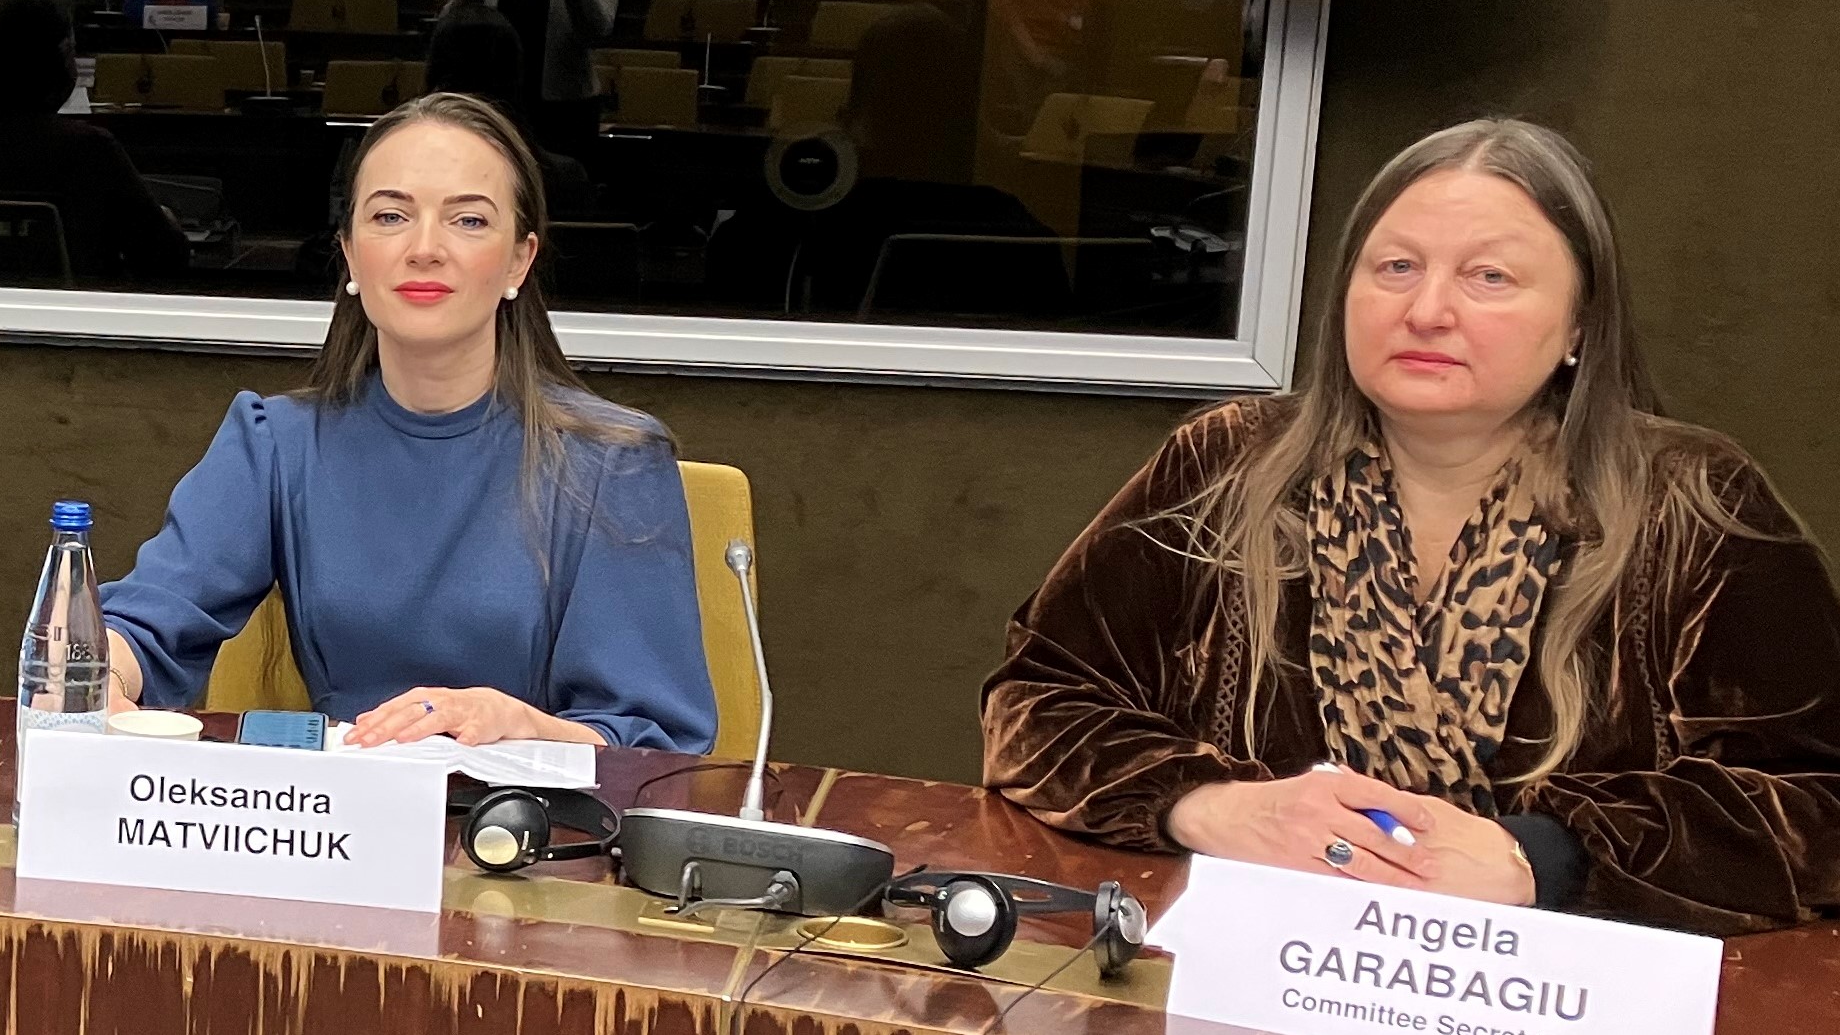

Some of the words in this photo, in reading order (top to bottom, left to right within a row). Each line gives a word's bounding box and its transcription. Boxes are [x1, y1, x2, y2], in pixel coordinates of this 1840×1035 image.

[129, 773, 331, 815] Oleksandra
[117, 816, 352, 861] MATVIICHUK
[722, 835, 803, 864] BOSCH
[1354, 899, 1520, 956] Angela
[1279, 939, 1589, 1022] GARABAGIU
[1282, 987, 1428, 1031] Committee
